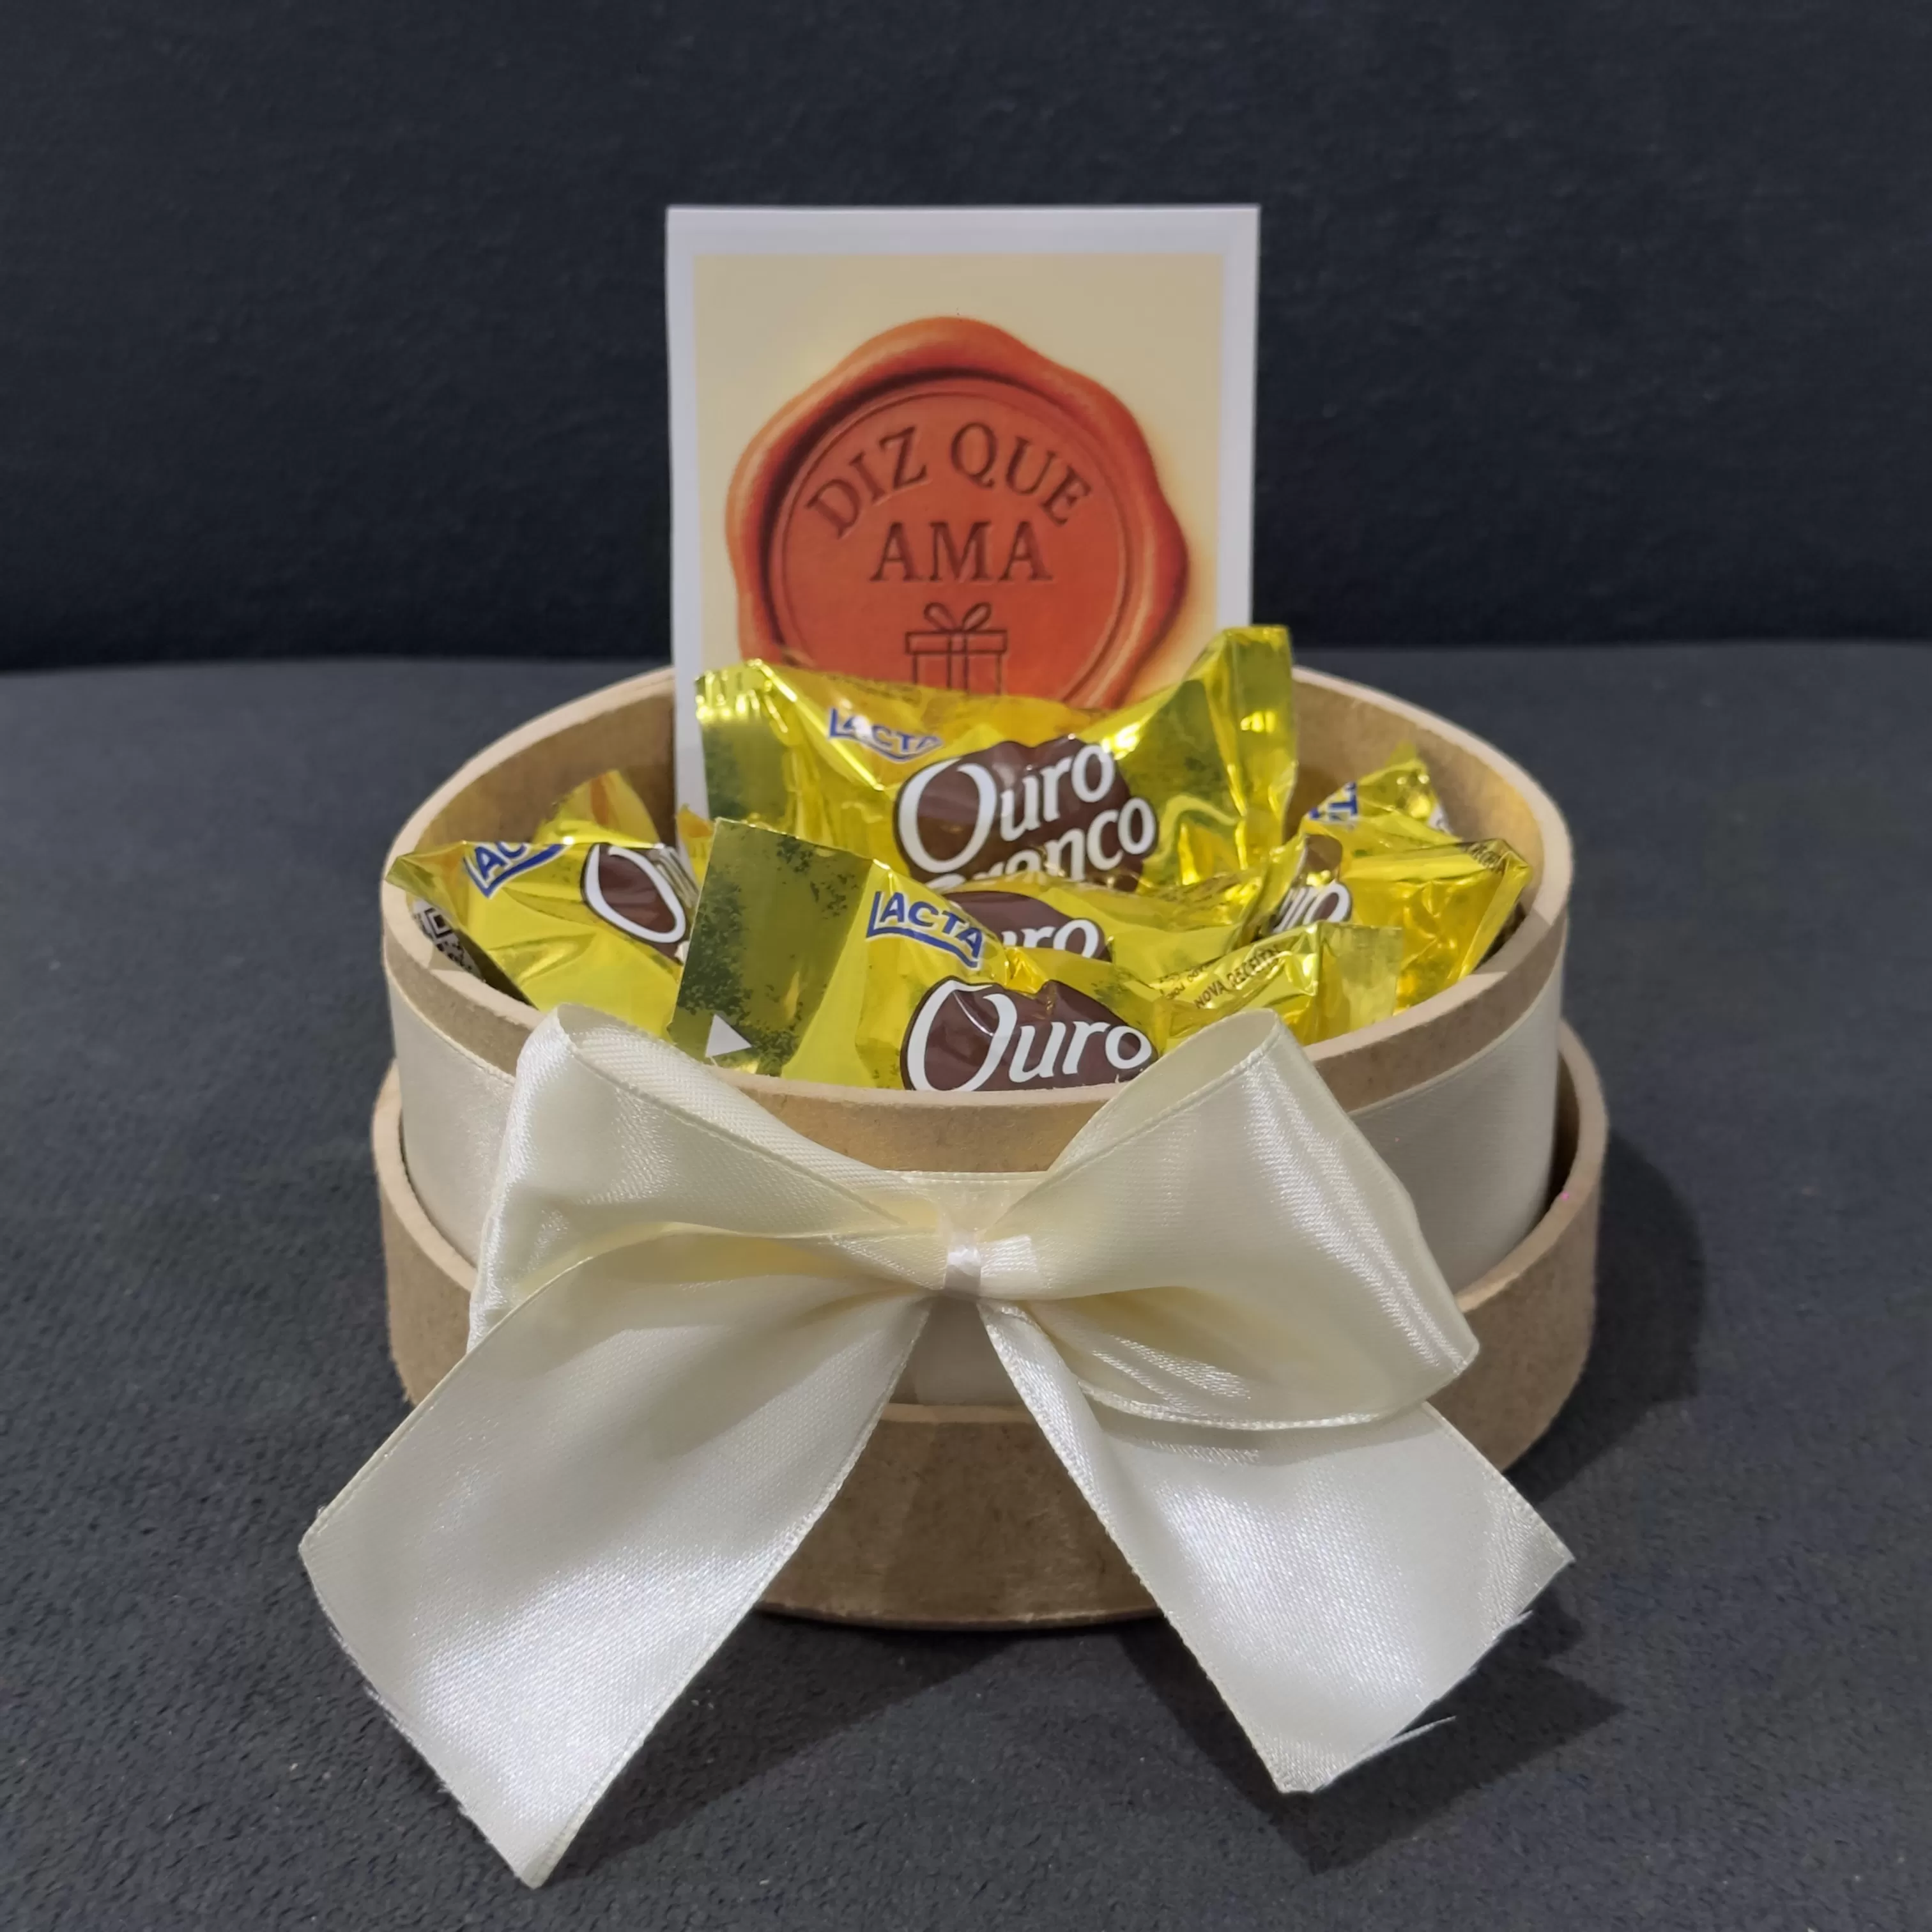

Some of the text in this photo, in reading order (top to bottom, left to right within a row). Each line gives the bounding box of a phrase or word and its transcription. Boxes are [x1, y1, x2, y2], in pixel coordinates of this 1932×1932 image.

[805, 421, 1091, 539] DIZ QUE
[869, 521, 1054, 582] AMA
[898, 744, 1116, 873] Ouro
[866, 890, 985, 969] LACTA
[906, 978, 1152, 1091] Ouro
[1193, 980, 1229, 1009] NOVA
